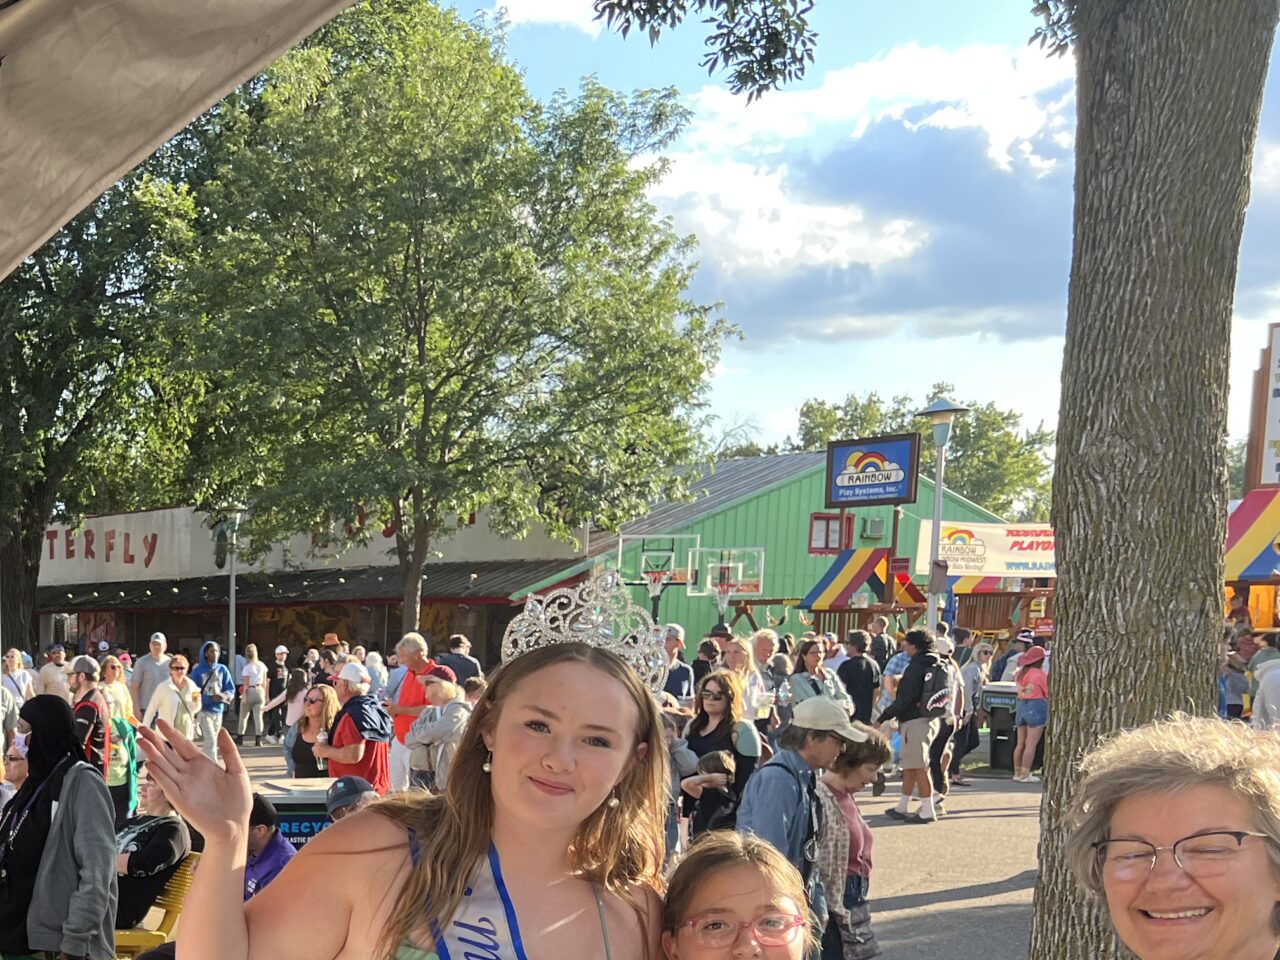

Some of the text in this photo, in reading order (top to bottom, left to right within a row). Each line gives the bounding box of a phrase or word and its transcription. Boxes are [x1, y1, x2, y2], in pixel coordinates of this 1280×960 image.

[848, 472, 892, 484] RAINBOW
[839, 489, 853, 497] Play
[941, 546, 977, 554] RAINBOW
